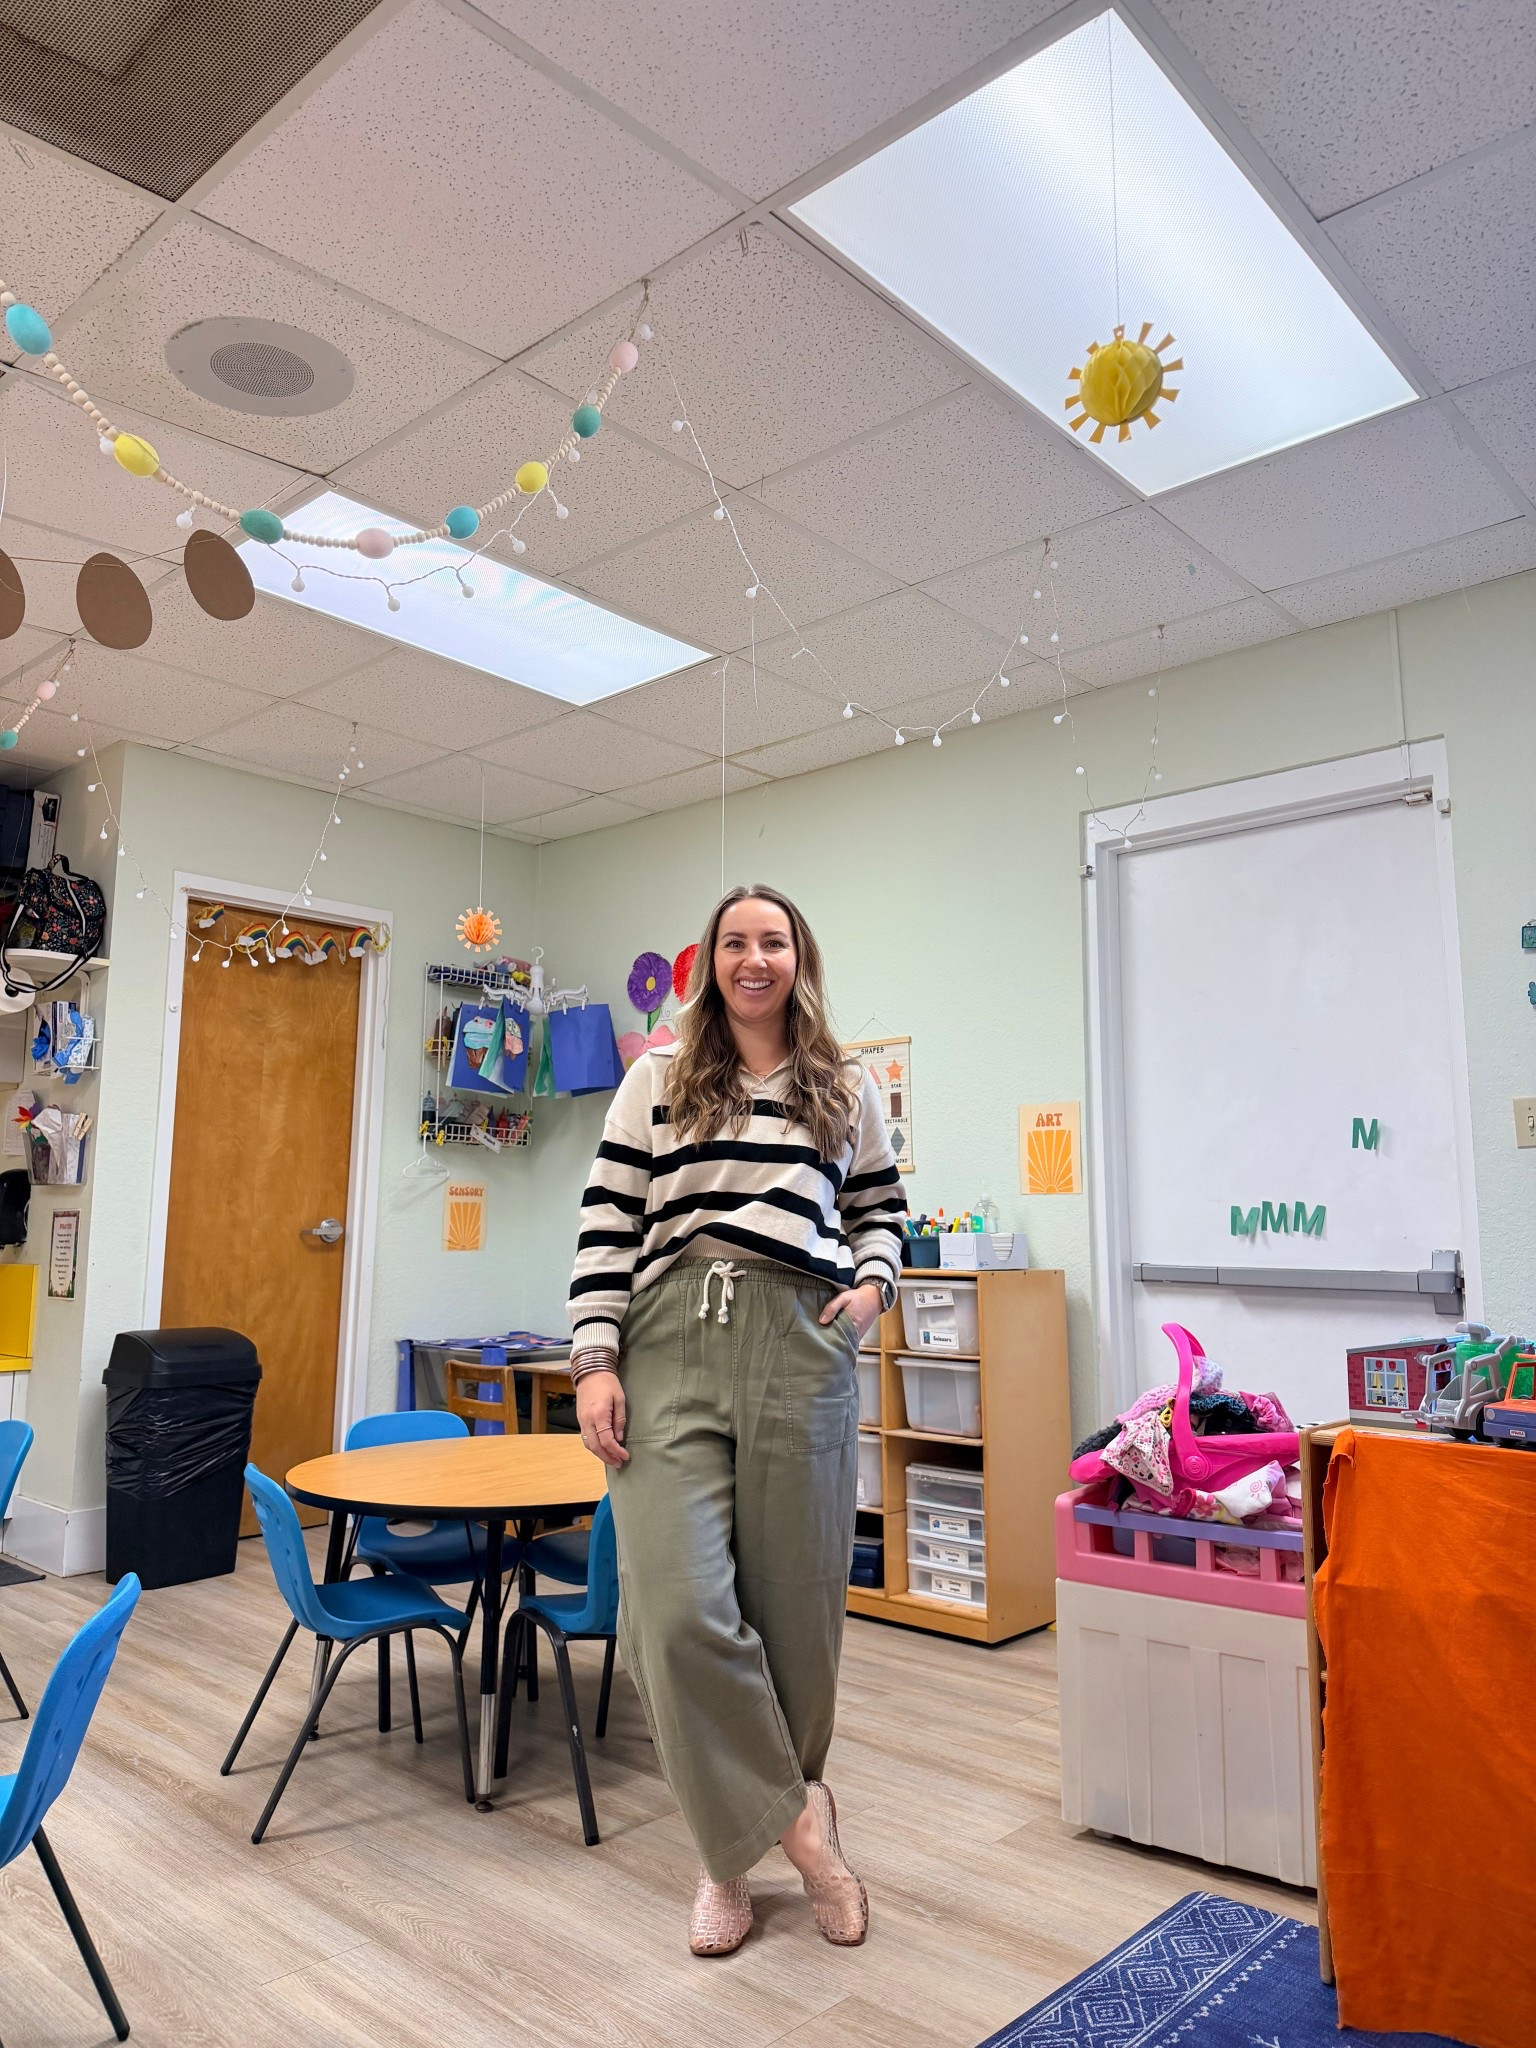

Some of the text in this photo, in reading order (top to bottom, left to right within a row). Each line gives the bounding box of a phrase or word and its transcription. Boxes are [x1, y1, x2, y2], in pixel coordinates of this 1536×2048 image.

[861, 1047, 884, 1055] SHAPES
[1036, 1113, 1062, 1127] ART
[1352, 1118, 1378, 1150] M
[449, 1186, 484, 1197] SENSORY
